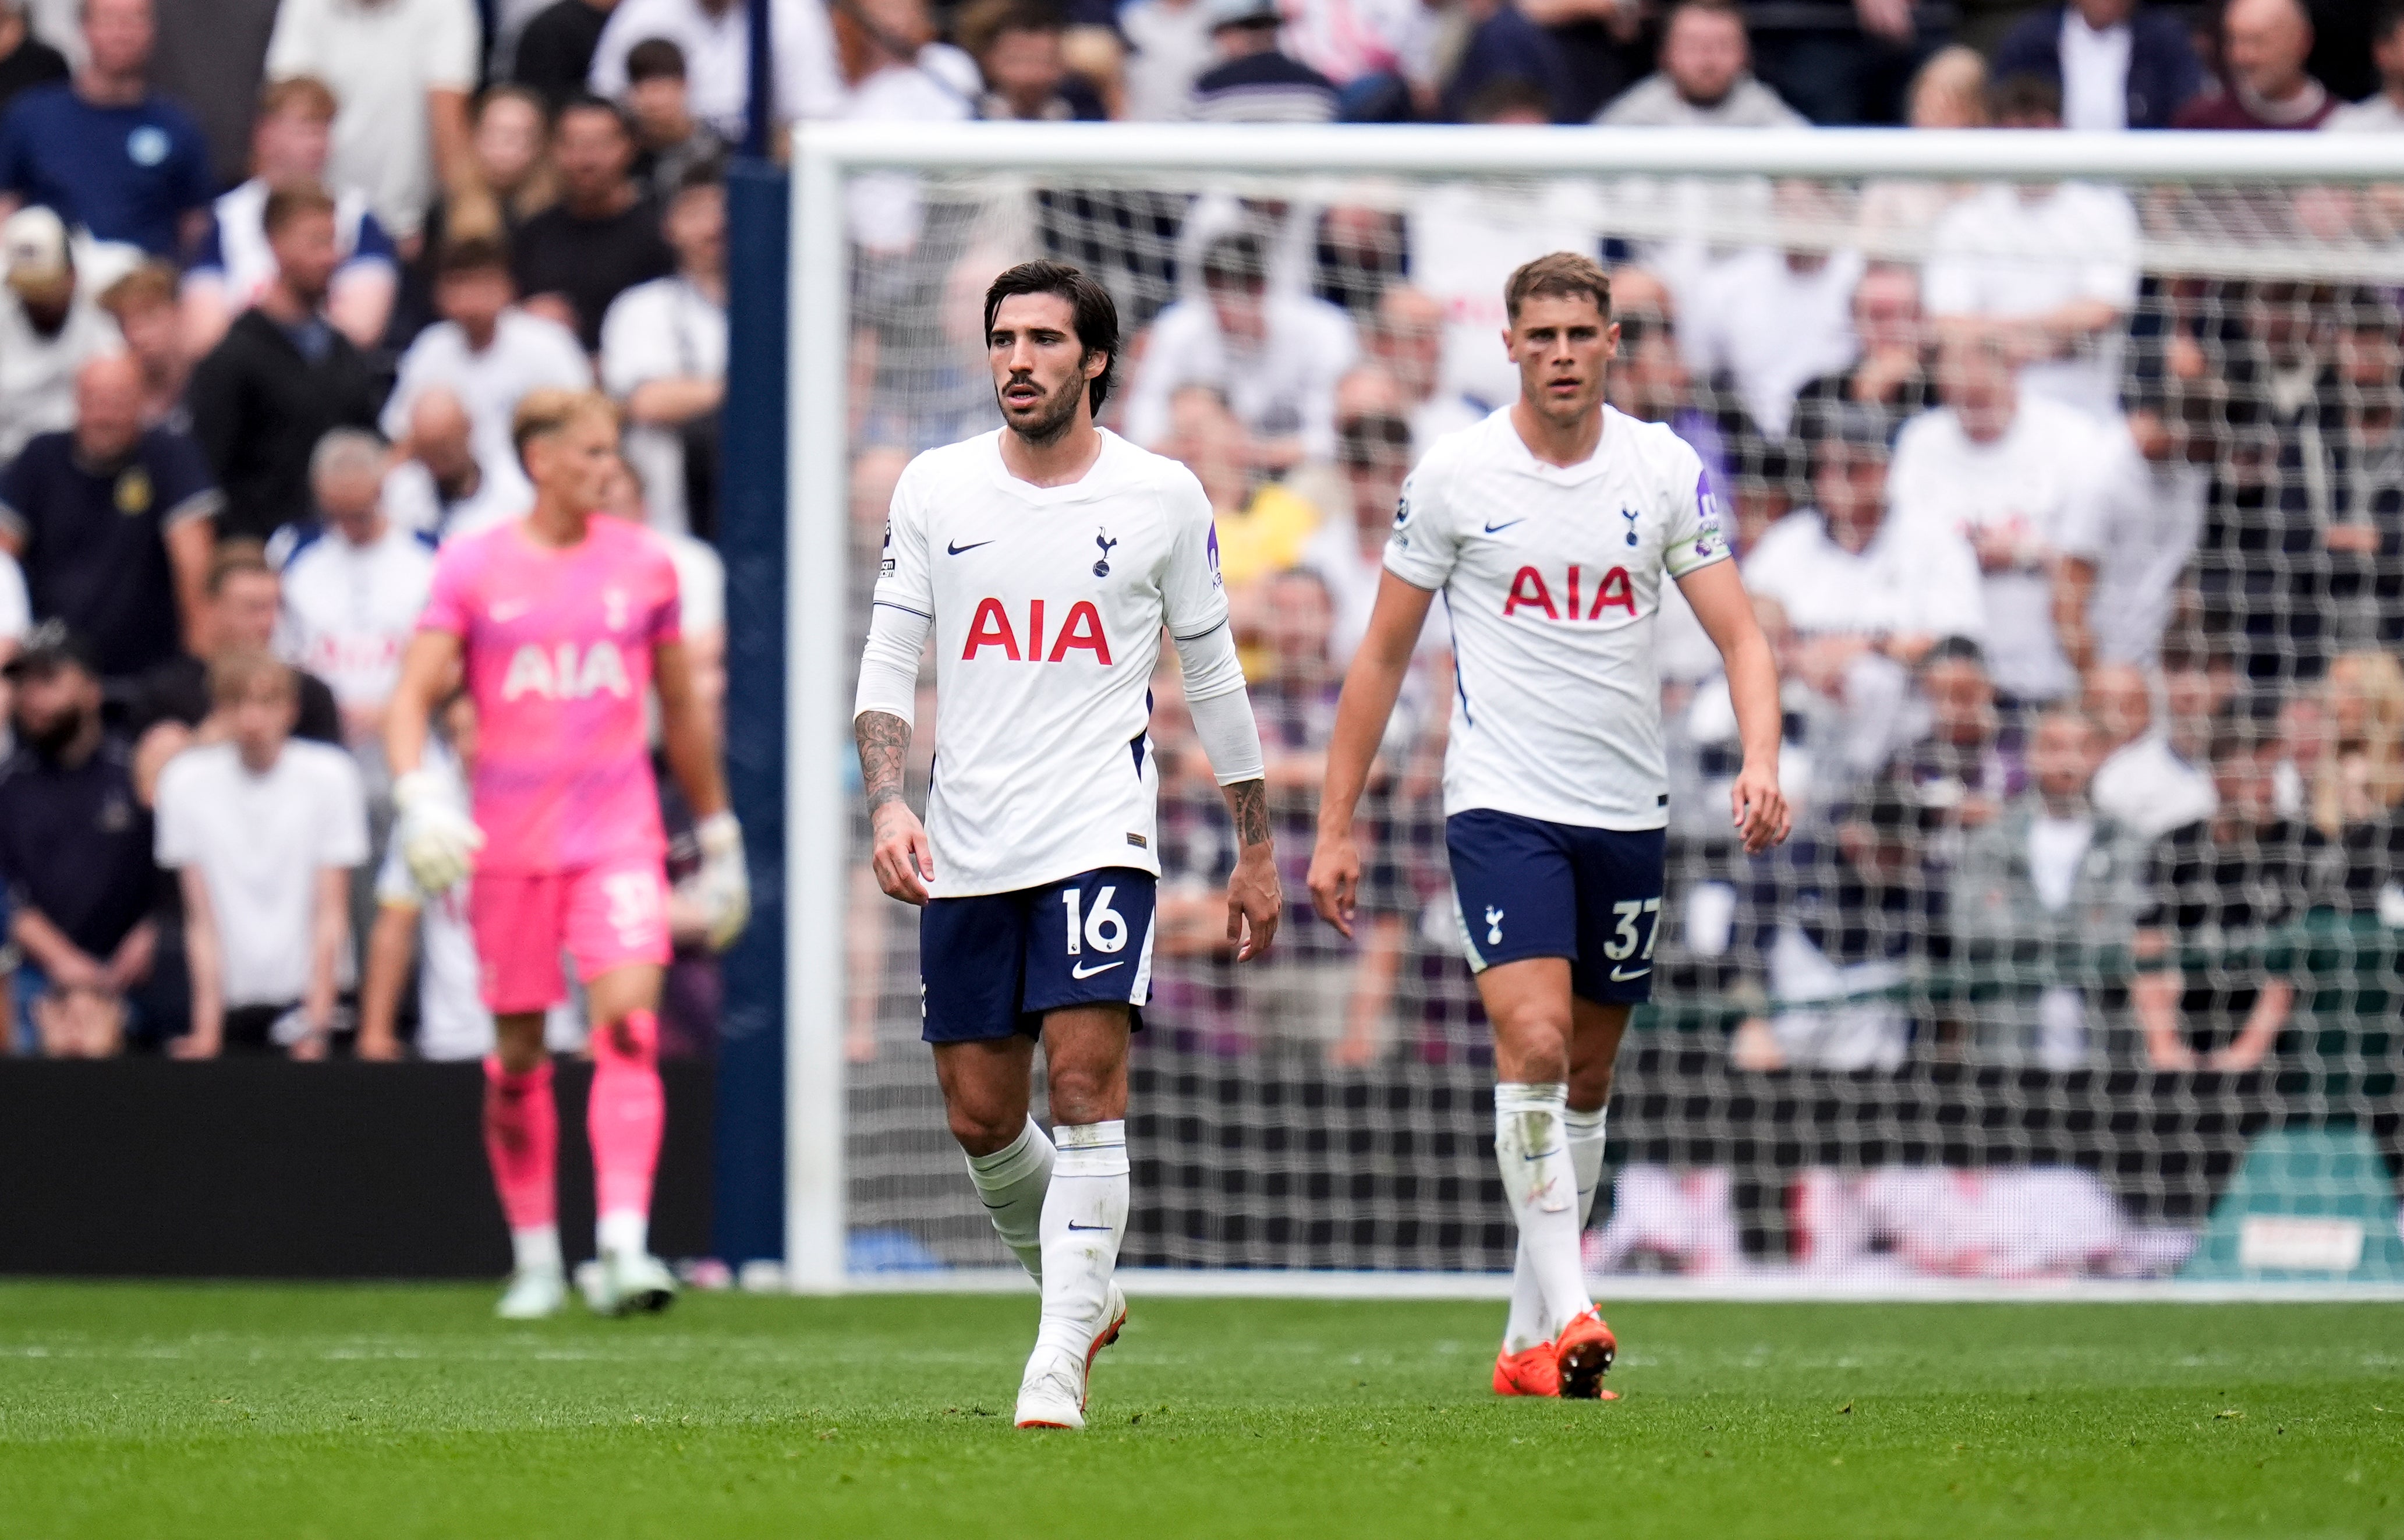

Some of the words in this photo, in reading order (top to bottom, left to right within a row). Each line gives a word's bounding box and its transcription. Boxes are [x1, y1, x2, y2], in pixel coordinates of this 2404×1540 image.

[1503, 565, 1638, 621] AIA
[961, 597, 1113, 665] AIA
[502, 641, 632, 701] AIA
[1062, 886, 1128, 955] 16
[1603, 897, 1662, 961] 37
